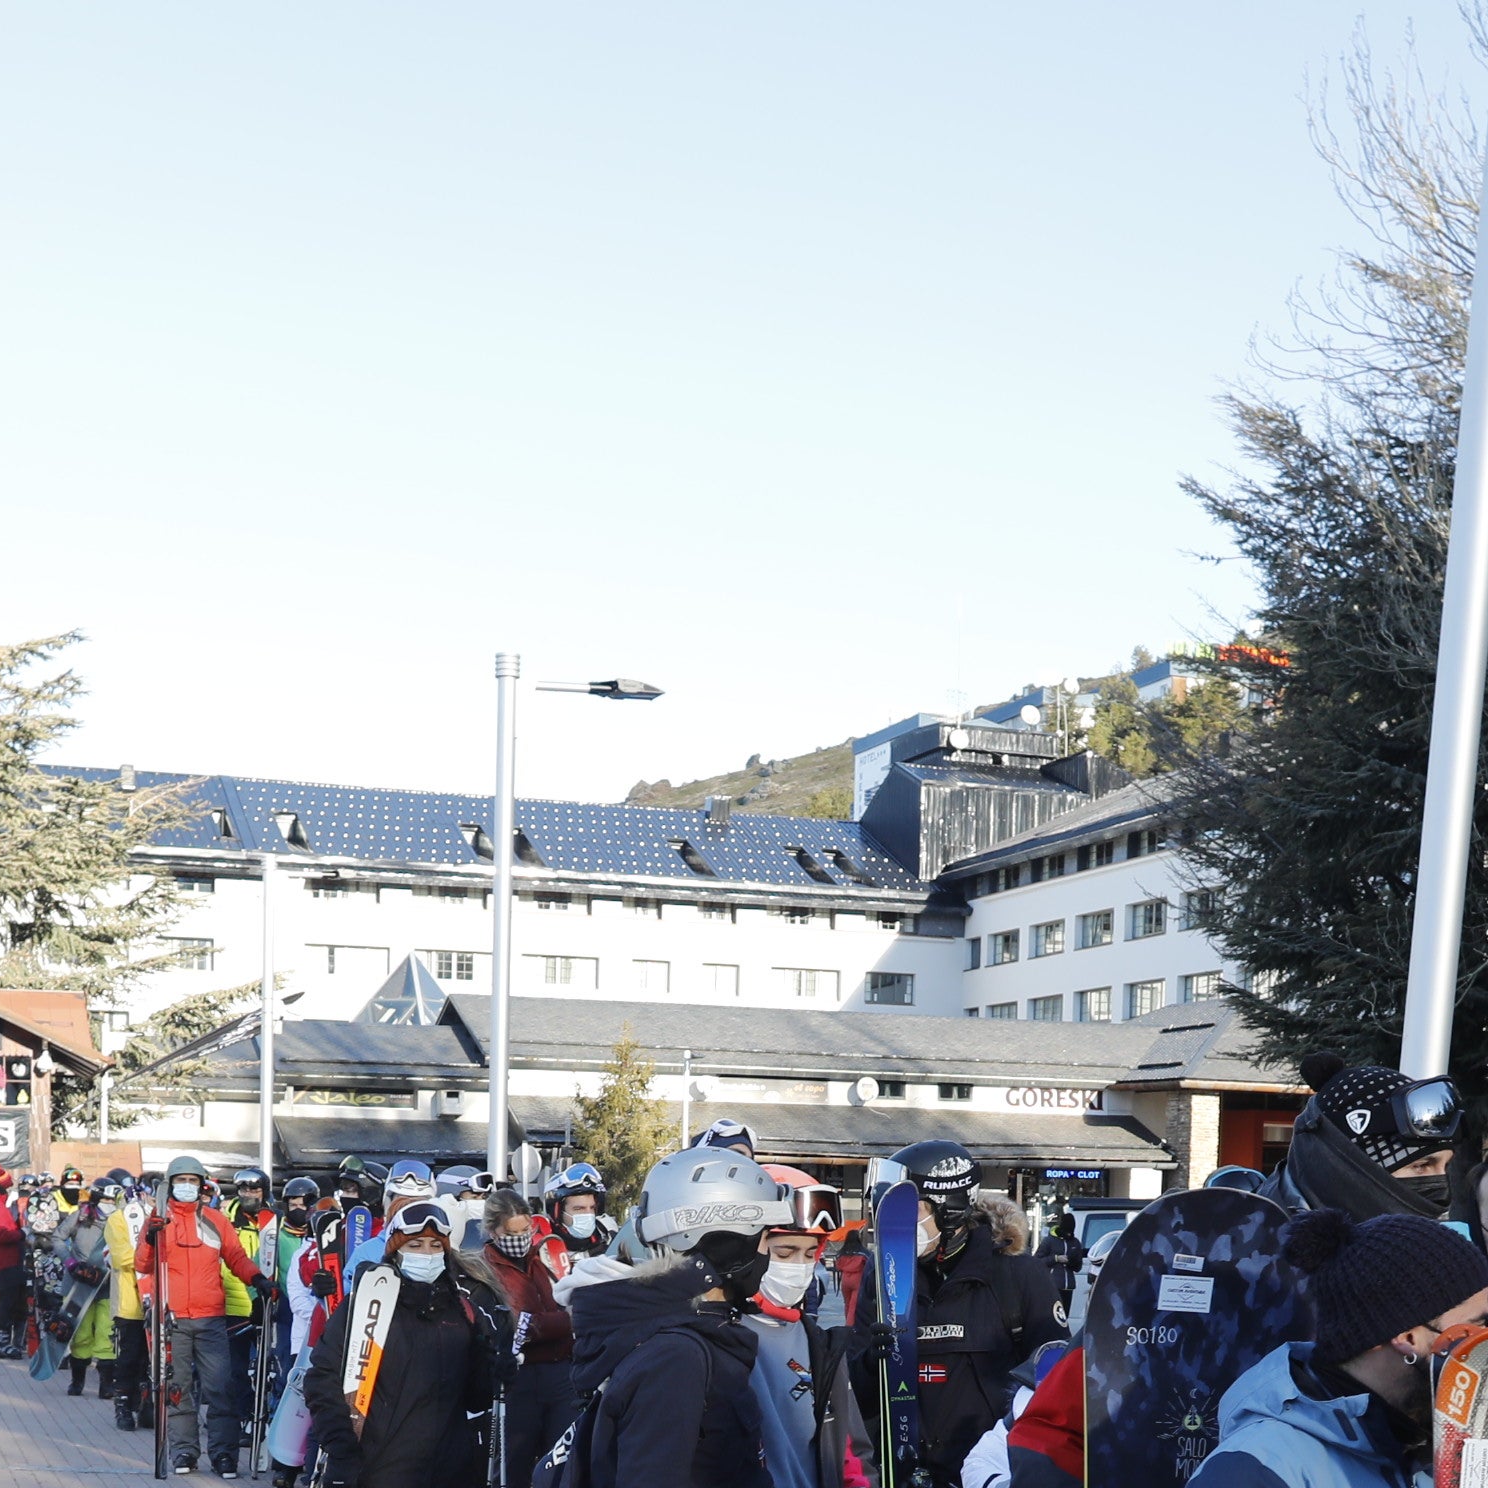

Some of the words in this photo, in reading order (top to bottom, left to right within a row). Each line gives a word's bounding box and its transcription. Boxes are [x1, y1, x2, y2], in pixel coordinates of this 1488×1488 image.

[1077, 1171, 1100, 1179] CLOT
[355, 1298, 382, 1382] HEAD
[1447, 1370, 1471, 1416] 150
[1177, 1436, 1207, 1457] SALO
